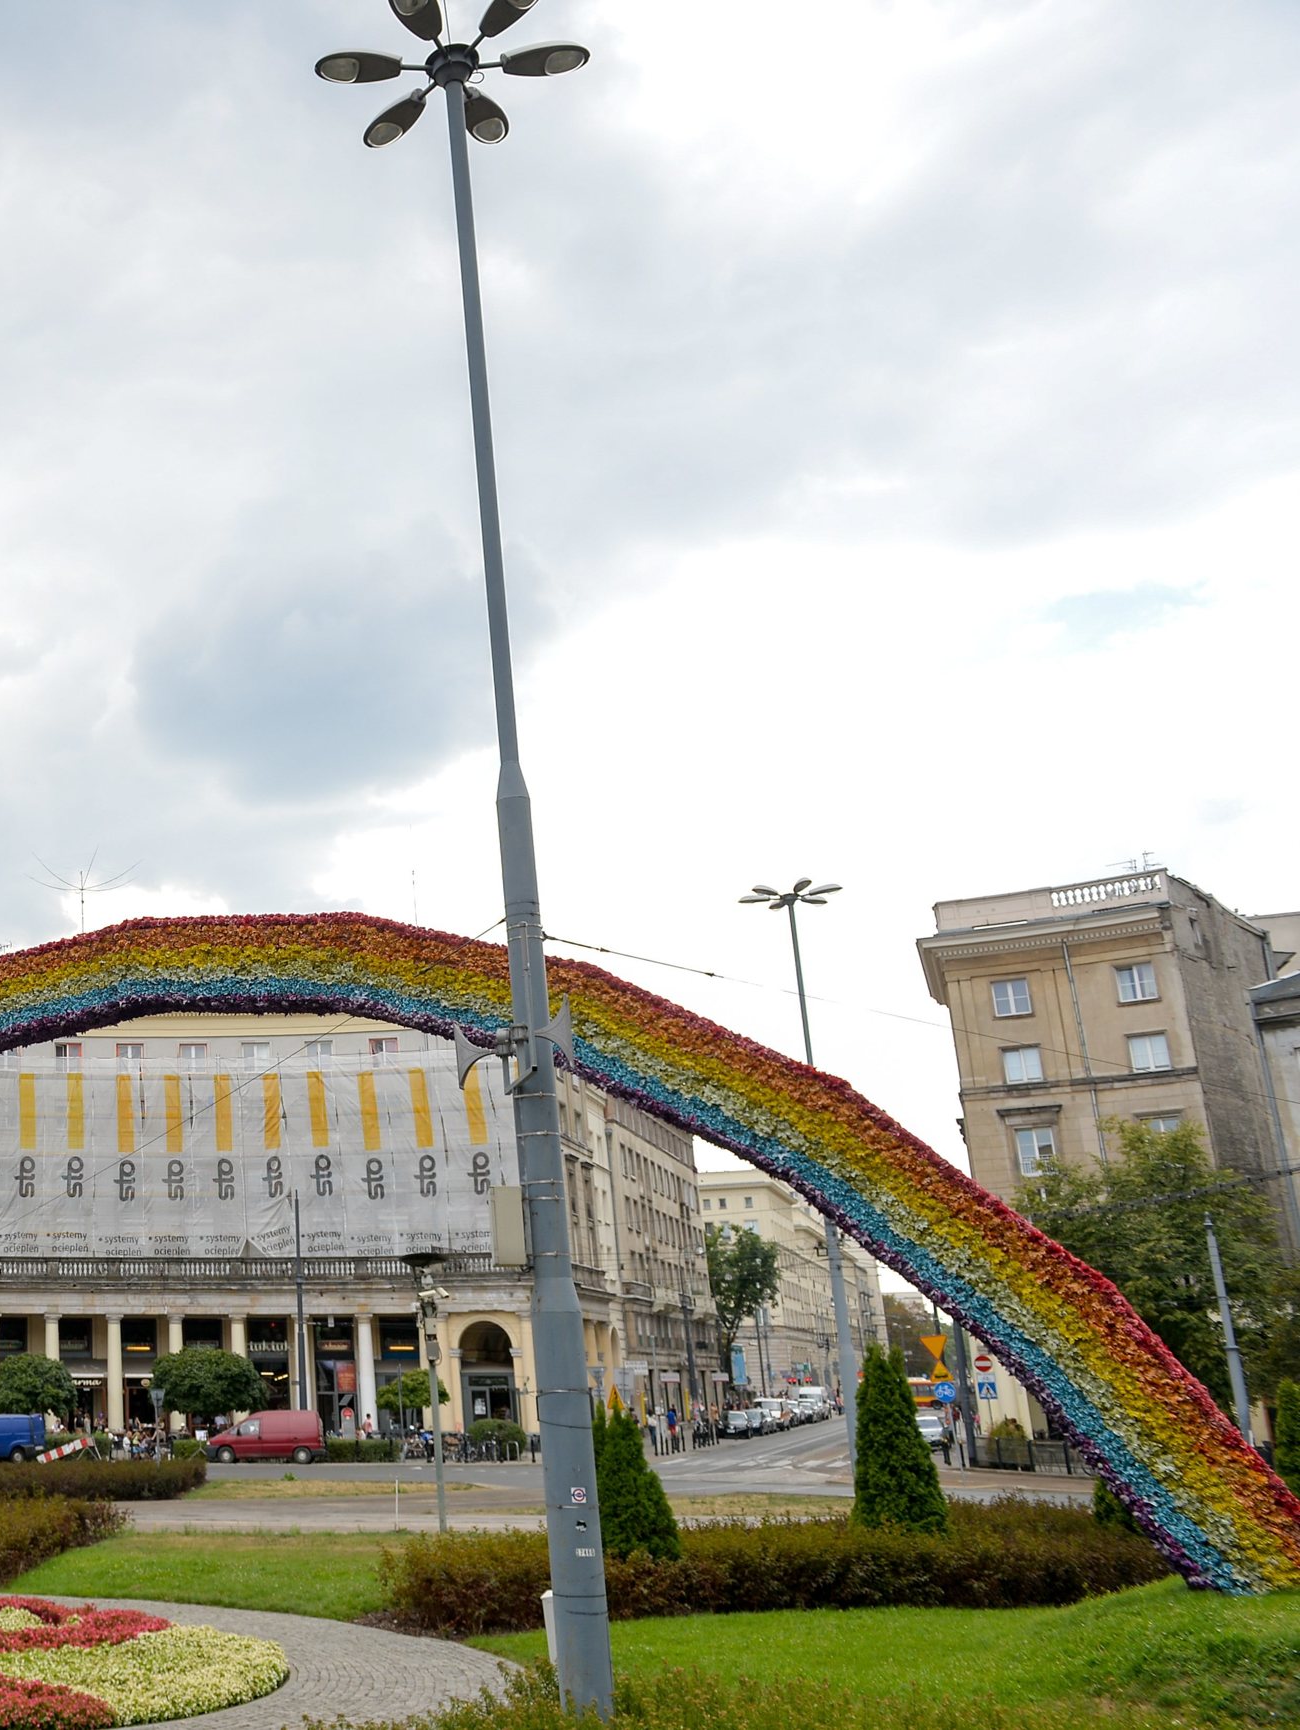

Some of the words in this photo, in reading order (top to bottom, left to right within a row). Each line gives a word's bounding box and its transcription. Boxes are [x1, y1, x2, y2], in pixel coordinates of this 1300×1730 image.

[14, 1156, 36, 1198] sto
[61, 1156, 84, 1198] sto
[113, 1160, 136, 1201] sto
[162, 1159, 184, 1201] sto
[212, 1158, 235, 1200] sto
[262, 1155, 283, 1198] sto
[310, 1154, 333, 1196] sto
[361, 1157, 385, 1200] sto
[414, 1154, 437, 1198] sto
[467, 1151, 491, 1195] sto
[4, 1231, 38, 1242] systemy
[52, 1230, 88, 1241] systemy
[104, 1234, 139, 1245] systemy
[154, 1234, 189, 1245] systemy
[205, 1234, 242, 1245] systemy
[256, 1224, 292, 1241] systemy
[306, 1230, 342, 1241] systemy
[356, 1234, 392, 1245] systemy
[405, 1231, 442, 1242] systemy
